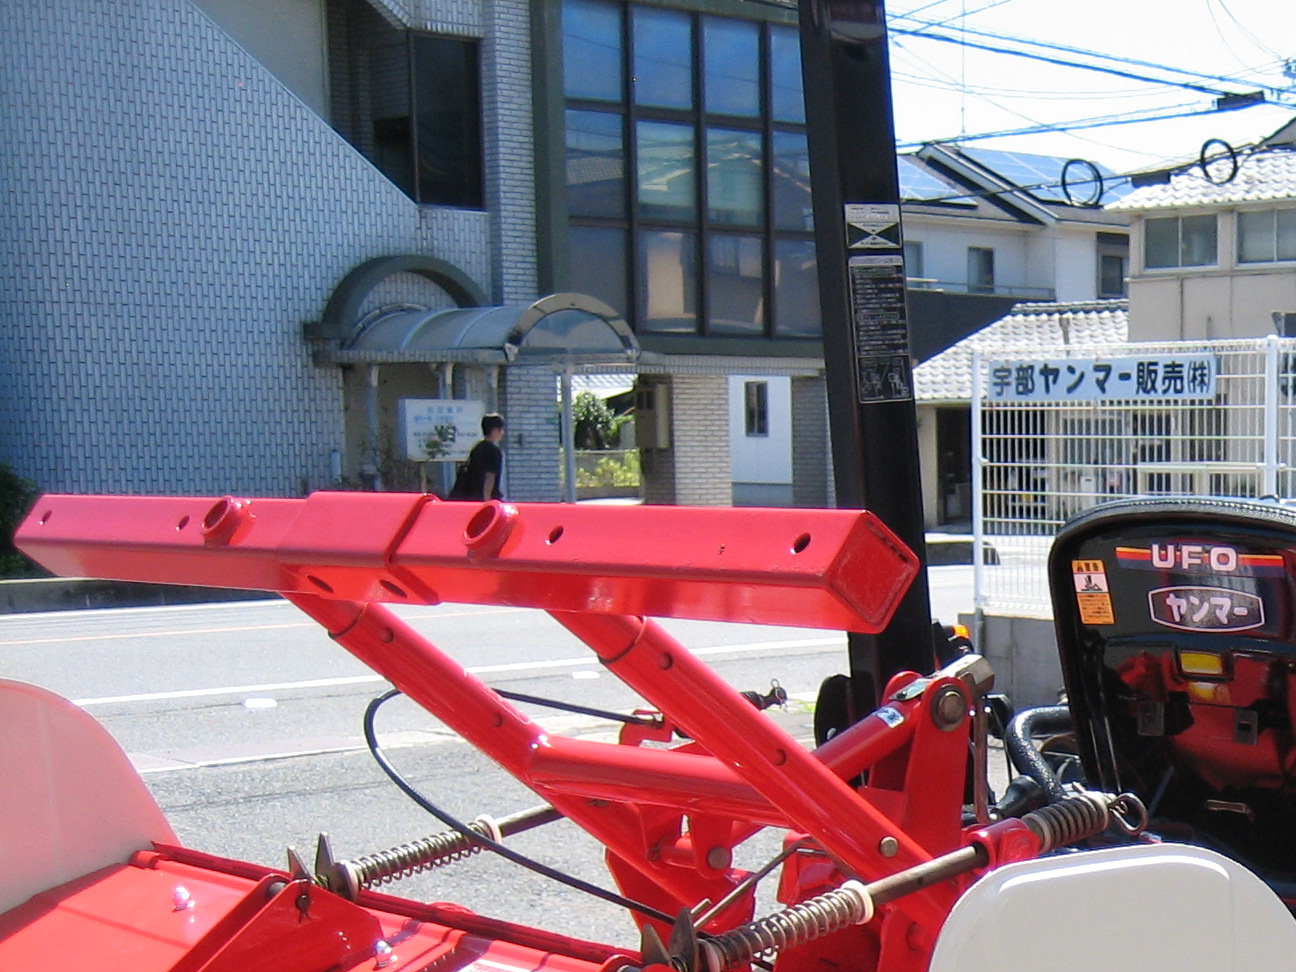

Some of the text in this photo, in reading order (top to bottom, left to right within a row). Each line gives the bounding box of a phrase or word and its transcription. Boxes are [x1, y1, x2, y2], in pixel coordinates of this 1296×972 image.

[1151, 543, 1238, 572] UFO
[1165, 593, 1249, 624] ヤンマー
